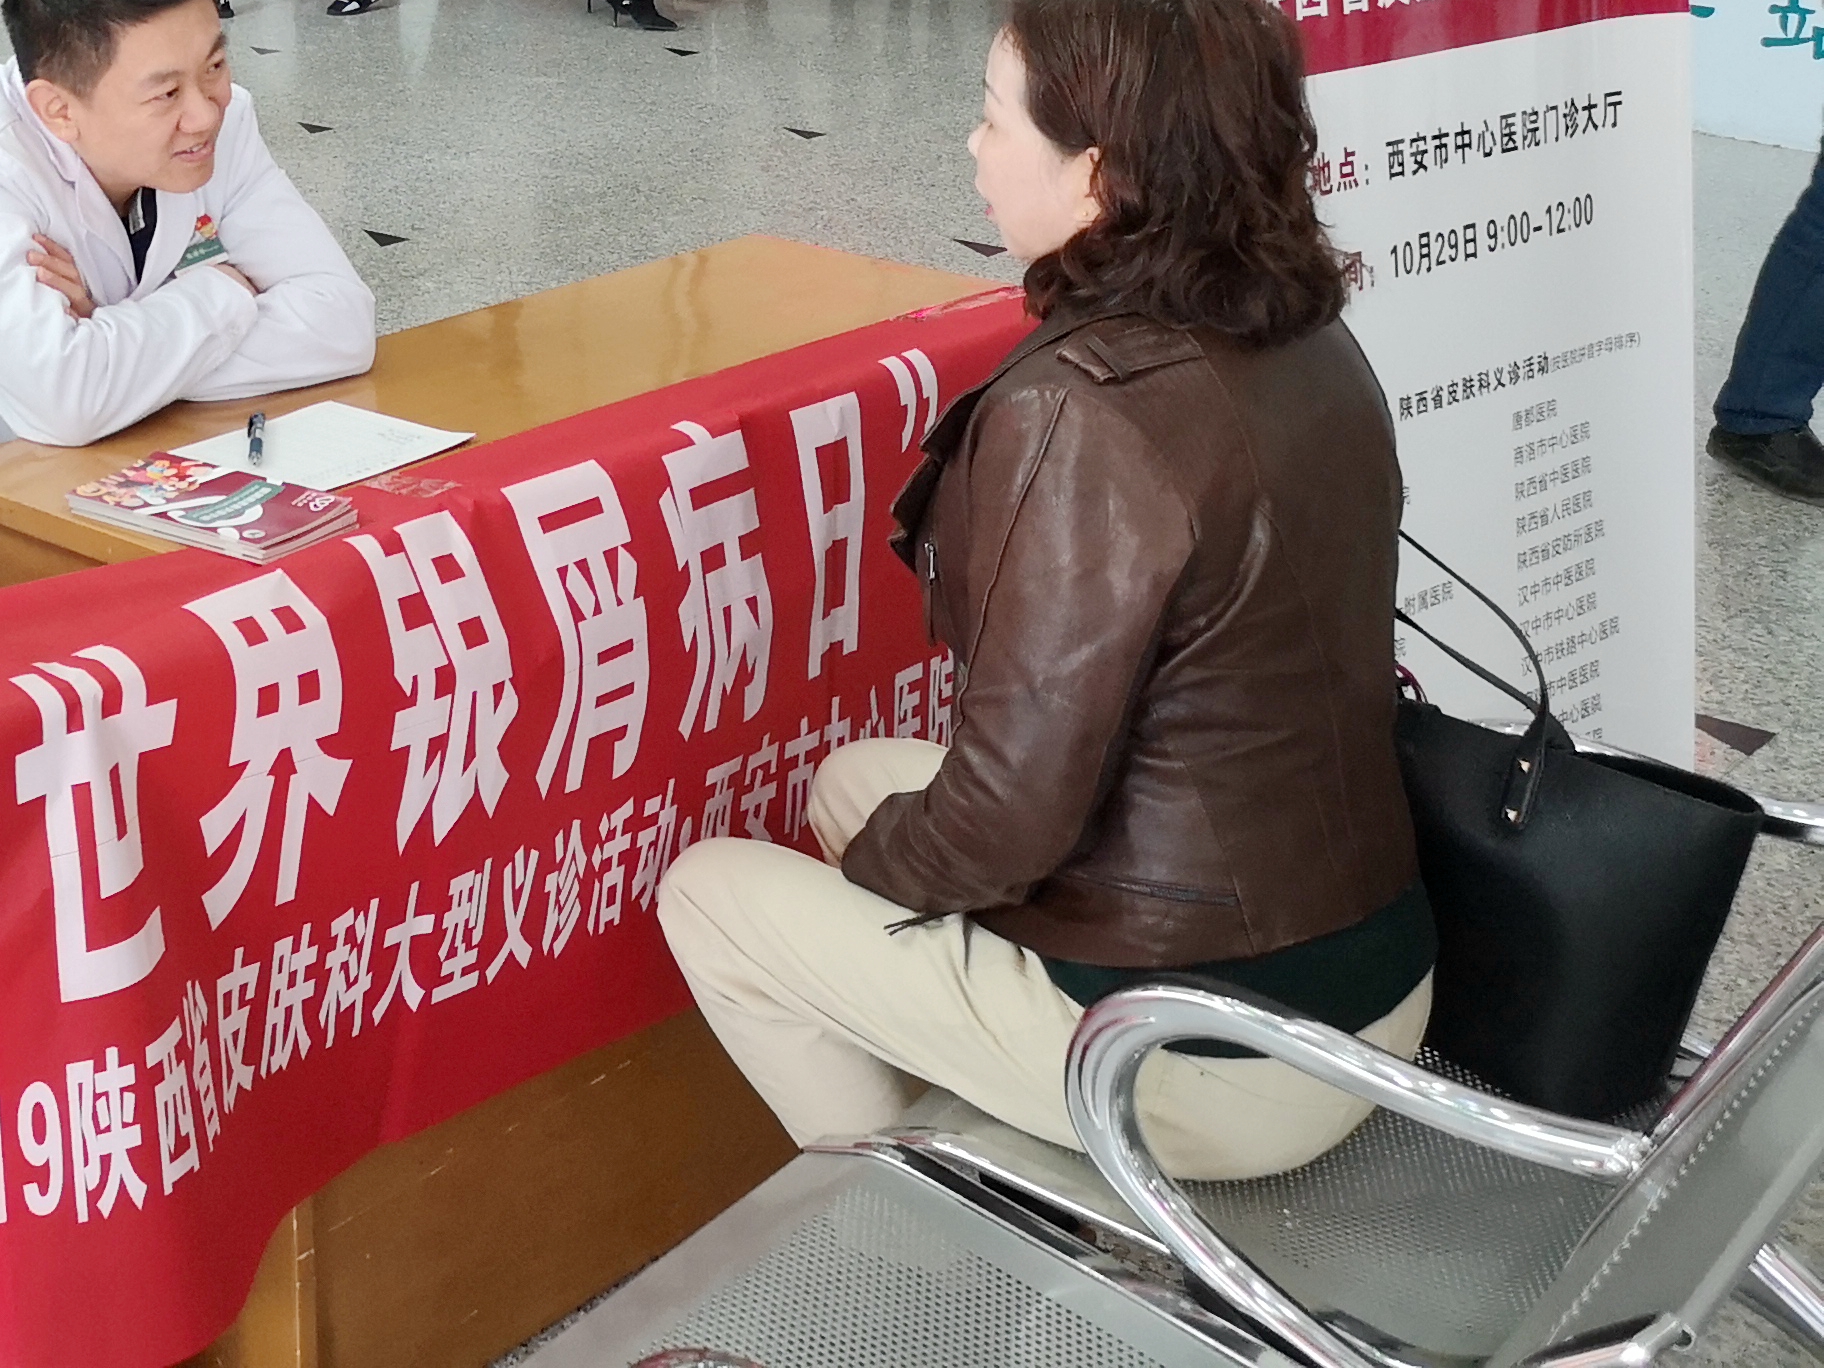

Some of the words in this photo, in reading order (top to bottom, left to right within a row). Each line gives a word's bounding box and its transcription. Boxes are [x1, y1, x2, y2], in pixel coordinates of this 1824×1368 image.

[1385, 90, 1623, 181] 西安市中心医院门诊大厅
[1390, 222, 1478, 280] 10月29日
[1486, 193, 1594, 253] 9:00-12:00
[1511, 398, 1558, 432] 唐都医院
[1513, 420, 1591, 468] 商洛市中心医院
[1514, 454, 1592, 502] 陕西省中医医院
[1515, 490, 1594, 538] 陕西省人民医院
[1397, 580, 1454, 618] 附属医院
[1517, 557, 1597, 608] 汉中市中医医院
[1519, 591, 1597, 639] 汉中市中心医院
[1554, 692, 1602, 726] 中心医院
